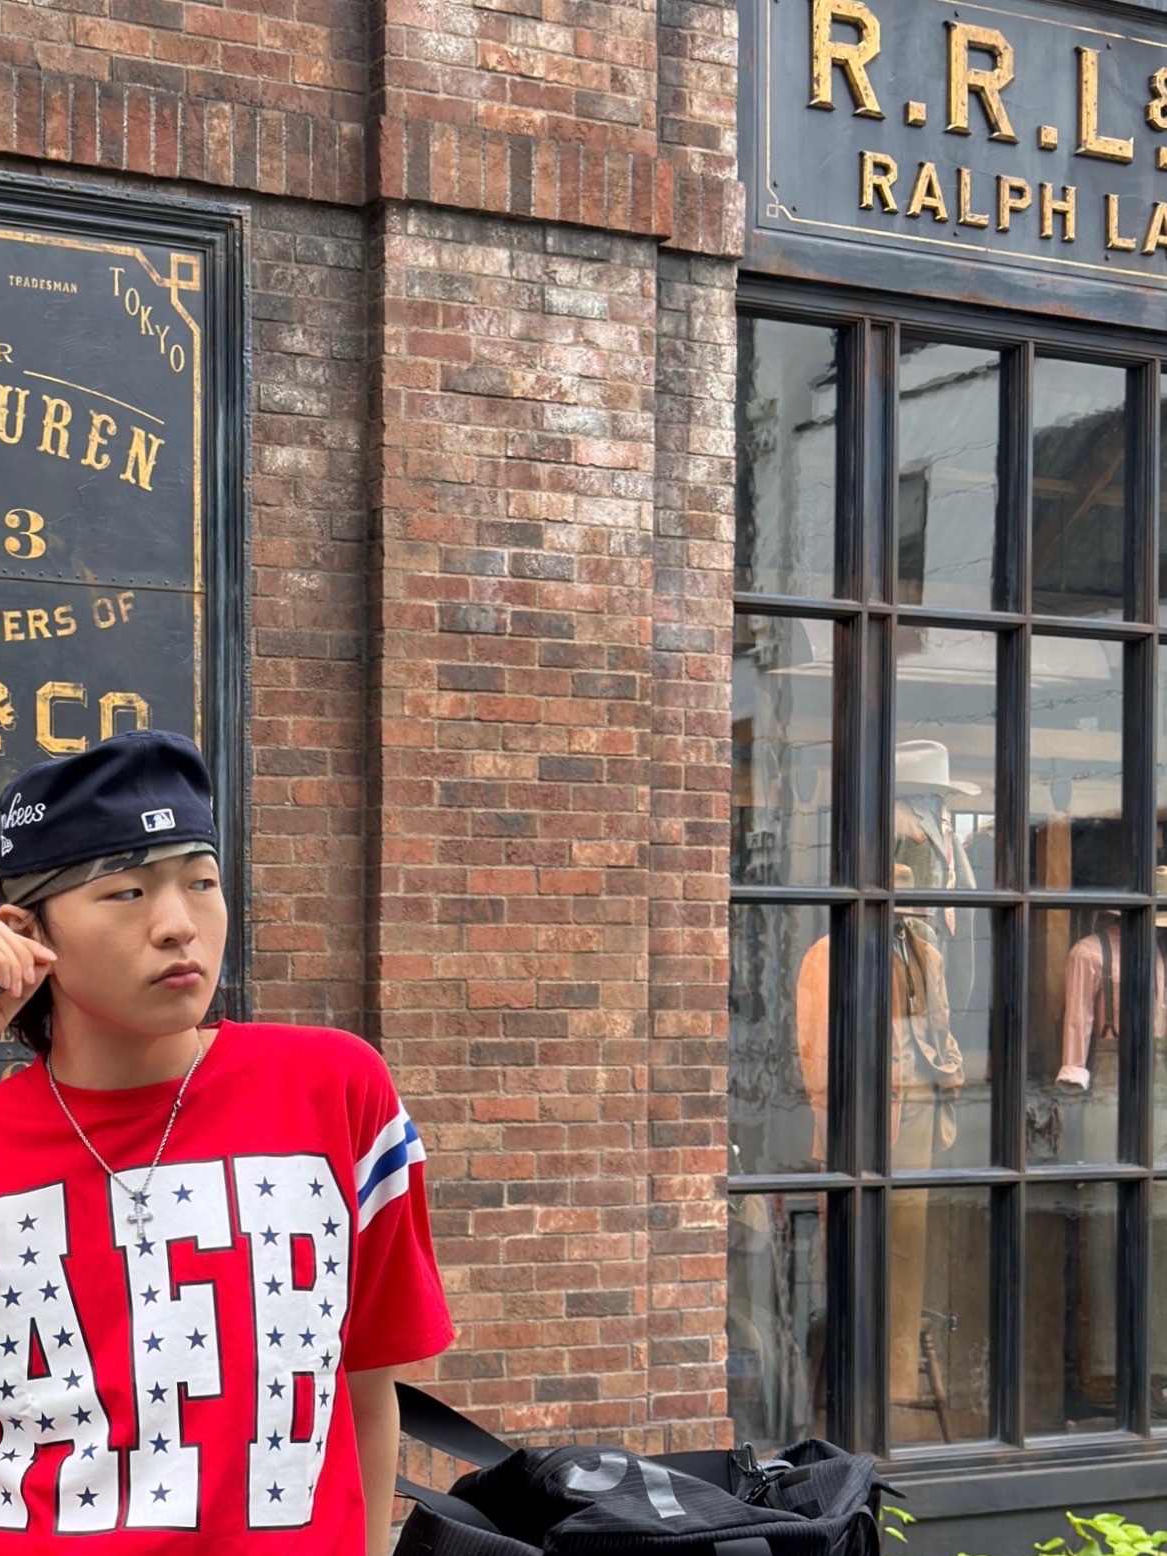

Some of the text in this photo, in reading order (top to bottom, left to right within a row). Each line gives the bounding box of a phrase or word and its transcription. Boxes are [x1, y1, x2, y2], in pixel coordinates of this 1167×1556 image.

[859, 150, 1077, 243] RALPH
[8, 275, 79, 295] TRADESMAN
[109, 266, 187, 374] TOKYO
[92, 591, 137, 630] OF
